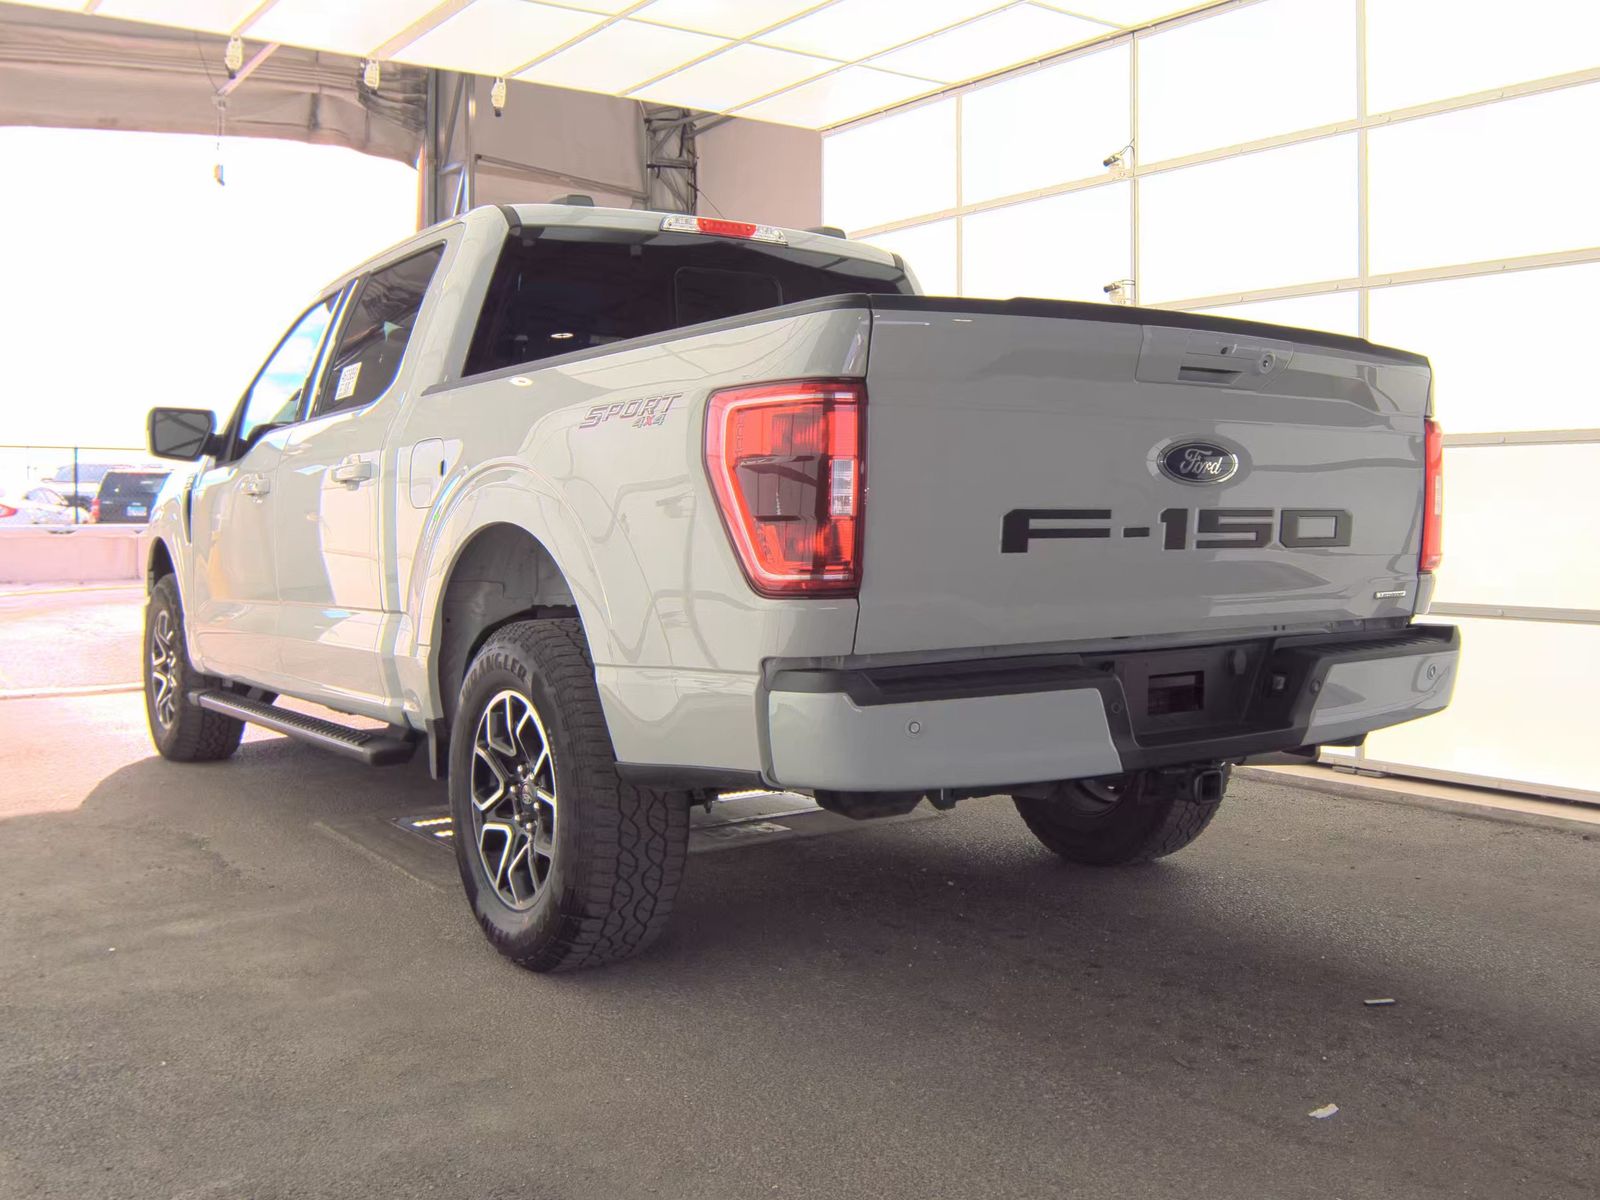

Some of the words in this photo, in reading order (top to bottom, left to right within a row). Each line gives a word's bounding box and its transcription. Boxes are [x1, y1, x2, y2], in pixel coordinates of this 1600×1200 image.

[579, 392, 683, 429] SPORT
[1180, 448, 1222, 474] Ford
[1001, 507, 1352, 554] F-150
